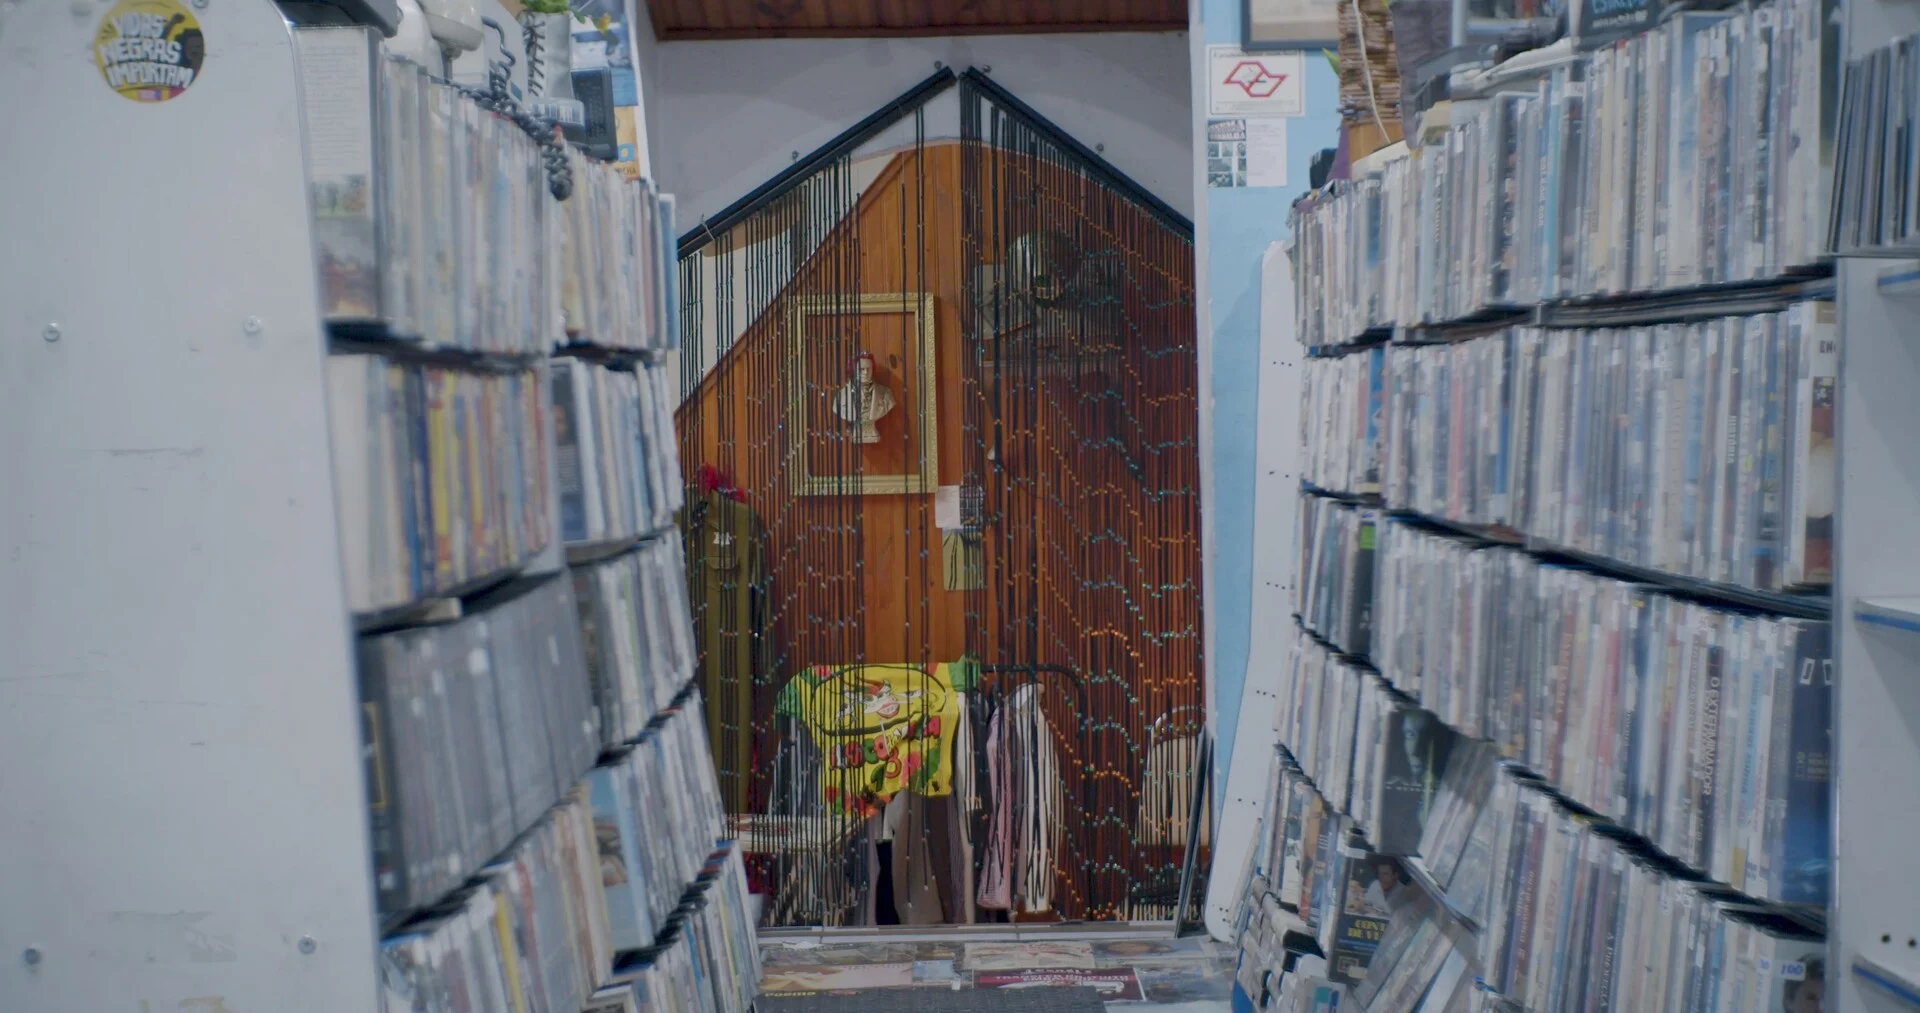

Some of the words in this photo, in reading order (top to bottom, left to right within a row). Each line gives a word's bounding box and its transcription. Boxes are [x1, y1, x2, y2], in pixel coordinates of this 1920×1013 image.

[100, 38, 182, 66] NEGRAS
[106, 62, 194, 88] IMPORTAM
[1703, 688, 1719, 795] EXTERMINADOR
